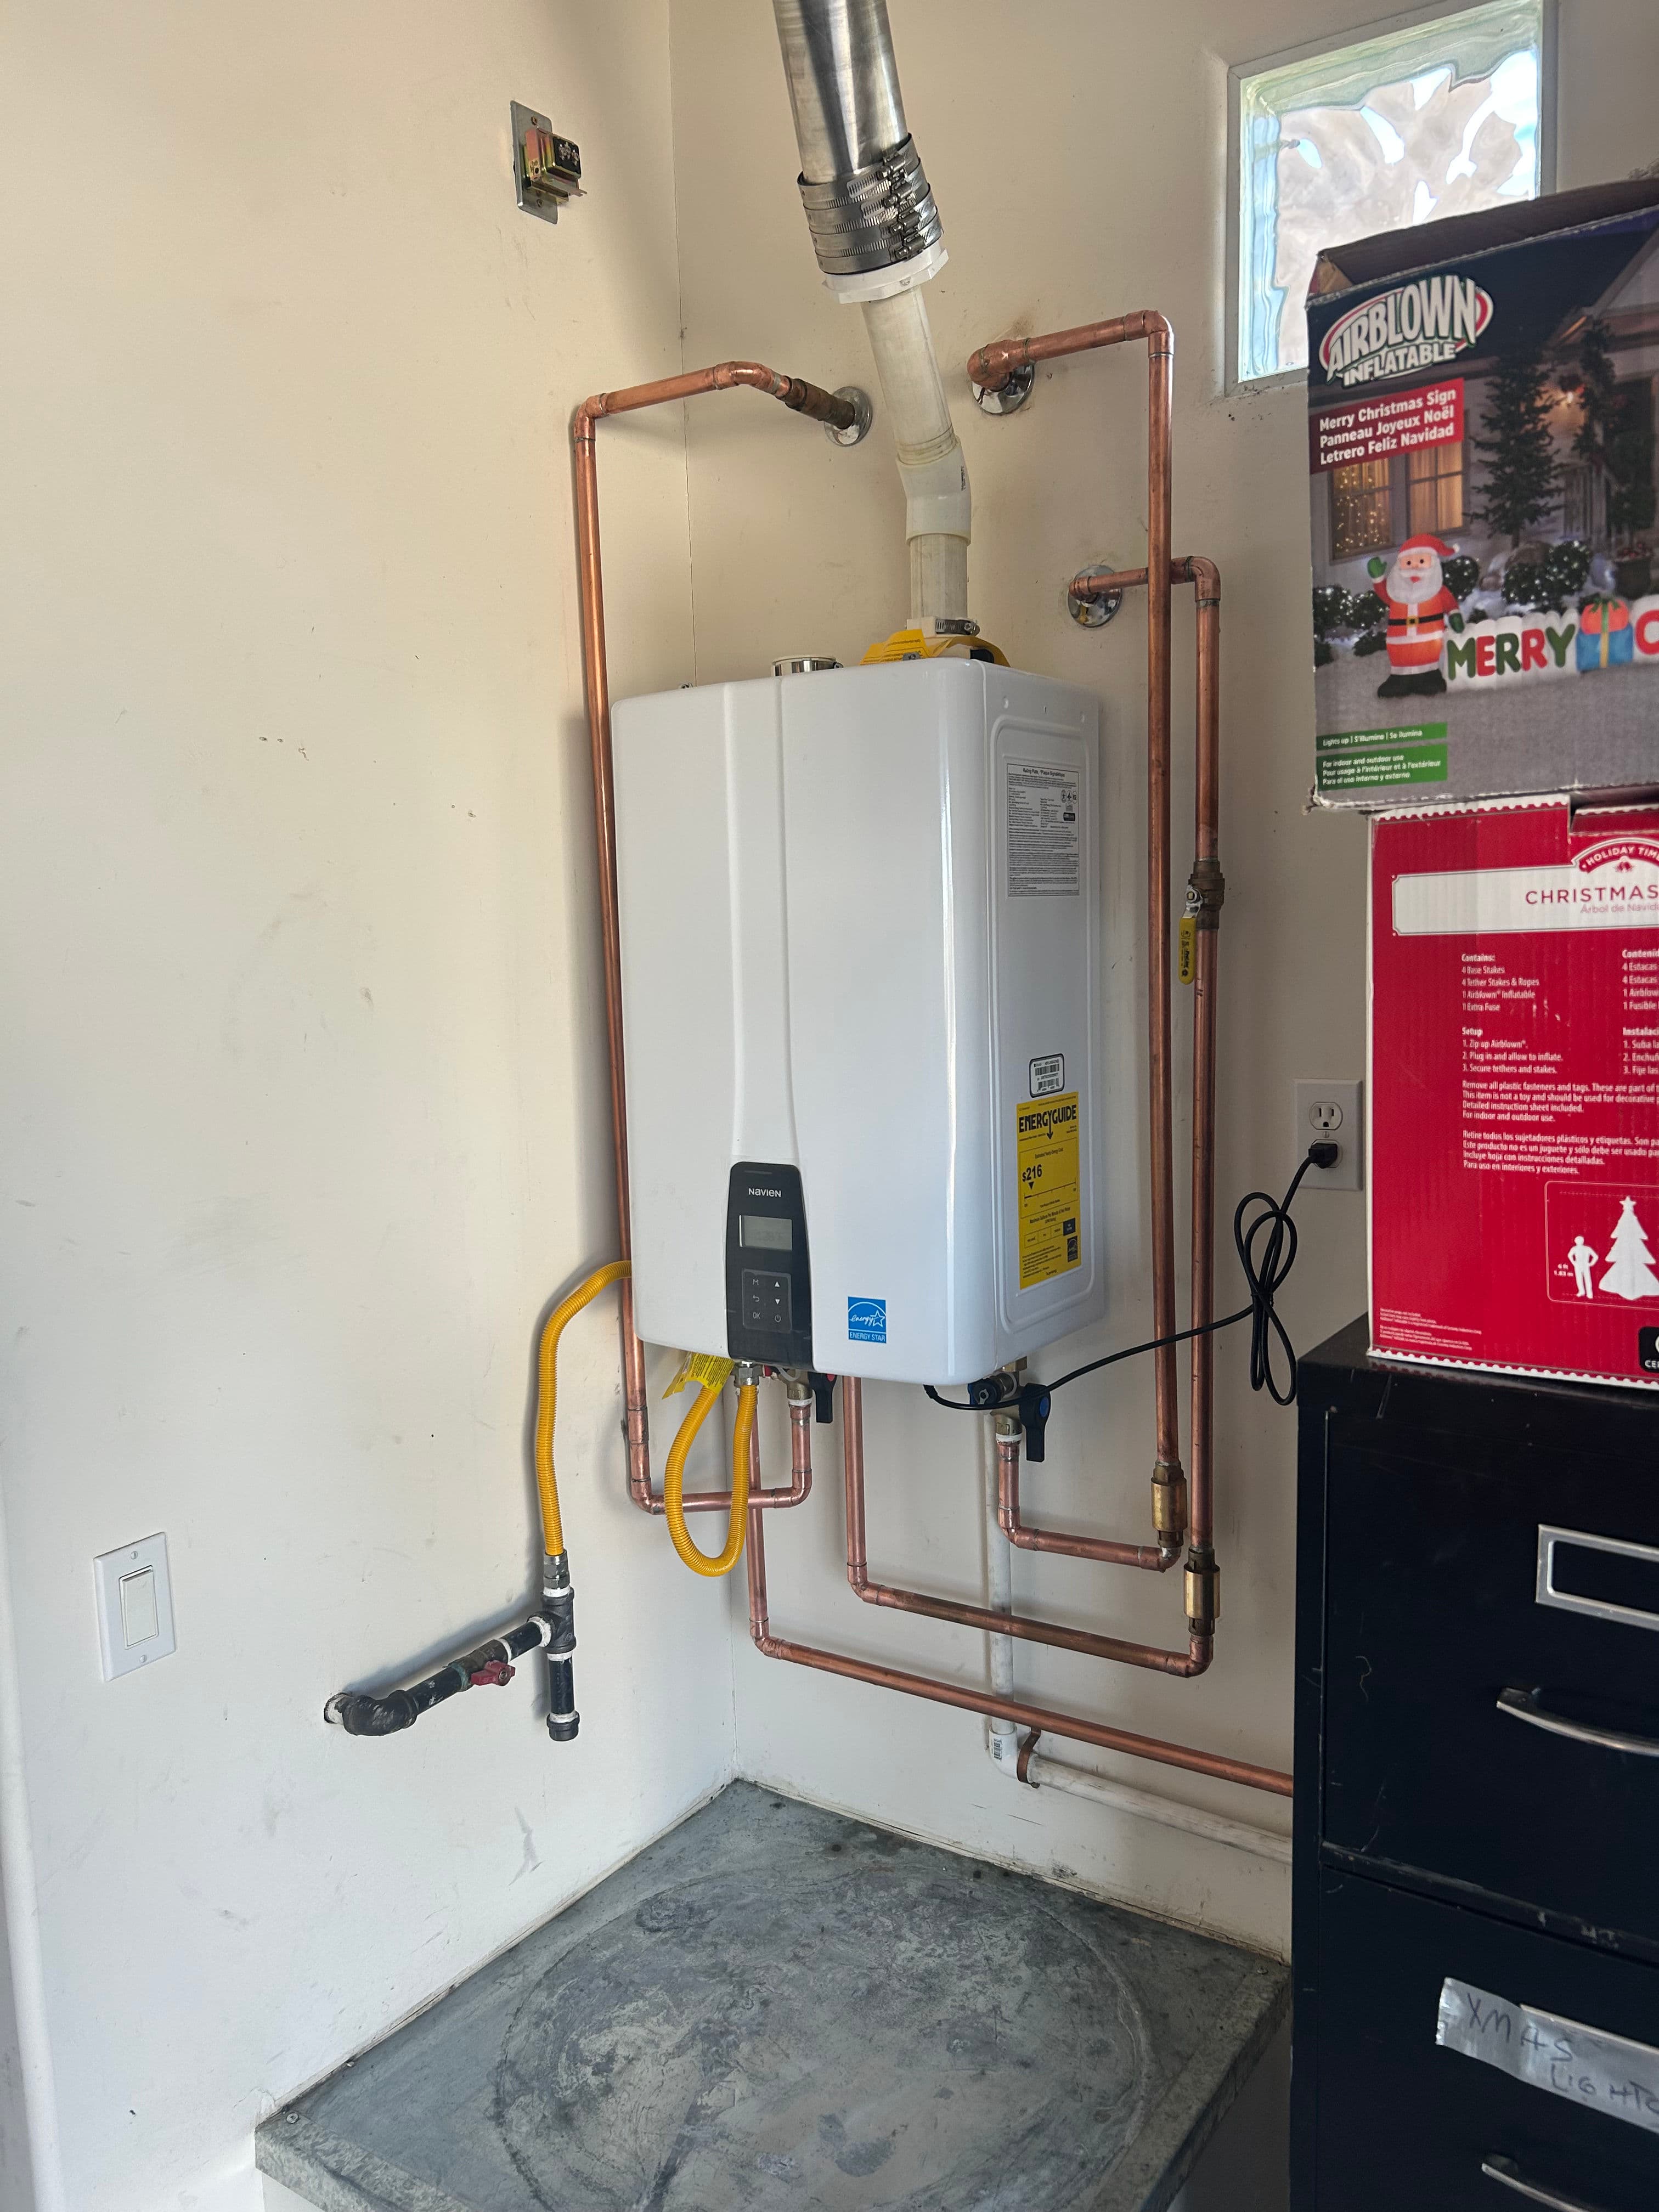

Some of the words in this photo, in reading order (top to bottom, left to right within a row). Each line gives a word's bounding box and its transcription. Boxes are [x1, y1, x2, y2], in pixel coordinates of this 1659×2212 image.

[1327, 275, 1476, 382] AIRBLOWN
[1343, 343, 1457, 386] INFLATABLE
[1320, 414, 1355, 431] Merry
[1358, 398, 1423, 422] Christmas
[1427, 390, 1456, 405] Sign
[1320, 427, 1373, 448] Panneau
[1376, 415, 1420, 436] Joyeux
[1424, 405, 1453, 424] Noël
[1321, 446, 1364, 465] Letrero
[1368, 437, 1397, 454] Feliz
[1401, 422, 1453, 447] Navidad
[1447, 624, 1576, 681] MERRY
[1366, 755, 1391, 764] outdoor
[1586, 847, 1634, 865] HOLIDAY
[1526, 884, 1658, 905] CHRISTMAS
[1461, 953, 1496, 962] Contains:
[1482, 966, 1505, 974] Stakes
[1622, 962, 1628, 970] 4
[1628, 962, 1657, 970] Estacas
[1487, 978, 1510, 986] Stakes
[1510, 978, 1517, 986] &
[1518, 978, 1539, 988] Ropes
[1628, 975, 1657, 984] Estacas
[1502, 990, 1535, 998] Inflatable
[1629, 1001, 1657, 1009] Fusible
[1462, 1027, 1483, 1037] Setup
[1469, 1040, 1479, 1049] Zip
[1469, 1052, 1484, 1062] Plug
[1508, 1052, 1527, 1060] allow
[1462, 1080, 1488, 1089] Remove
[1488, 1081, 1498, 1090] all
[1499, 1082, 1521, 1091] plastic
[1523, 1082, 1555, 1091] fasteners
[1592, 1083, 1613, 1092] These
[1628, 1085, 1645, 1093] part
[1645, 1083, 1655, 1092] of
[1462, 1090, 1475, 1098] This
[1519, 1093, 1531, 1102] toy
[1547, 1093, 1571, 1102] should
[1572, 1093, 1583, 1102] be
[1615, 1094, 1655, 1103] decorative
[1462, 1101, 1489, 1109] Detailed
[1491, 1102, 1528, 1110] instruction
[1019, 1104, 1076, 1133] ENERGYGUIDE
[1462, 1110, 1473, 1118] For
[1511, 1113, 1539, 1121] outdoor
[1463, 1130, 1481, 1138] Retire
[1482, 1132, 1502, 1140] todos
[1514, 1133, 1555, 1143] sujetadores
[1589, 1137, 1594, 1145] y
[1634, 1137, 1649, 1145] Son
[1463, 1140, 1477, 1148] Este
[1477, 1142, 1508, 1150] producto
[1539, 1144, 1567, 1153] juguete
[1590, 1146, 1610, 1154] debe
[1463, 1150, 1486, 1160] Incluye
[1487, 1152, 1503, 1161] hoja
[1517, 1153, 1564, 1163] instrucciones
[1022, 1164, 1042, 1182] $216
[1463, 1160, 1477, 1169] Para
[1502, 1163, 1535, 1172] interiores
[1536, 1165, 1541, 1174] y
[872, 1334, 885, 1342] STAR
[1466, 1992, 1575, 2062] XMAS
